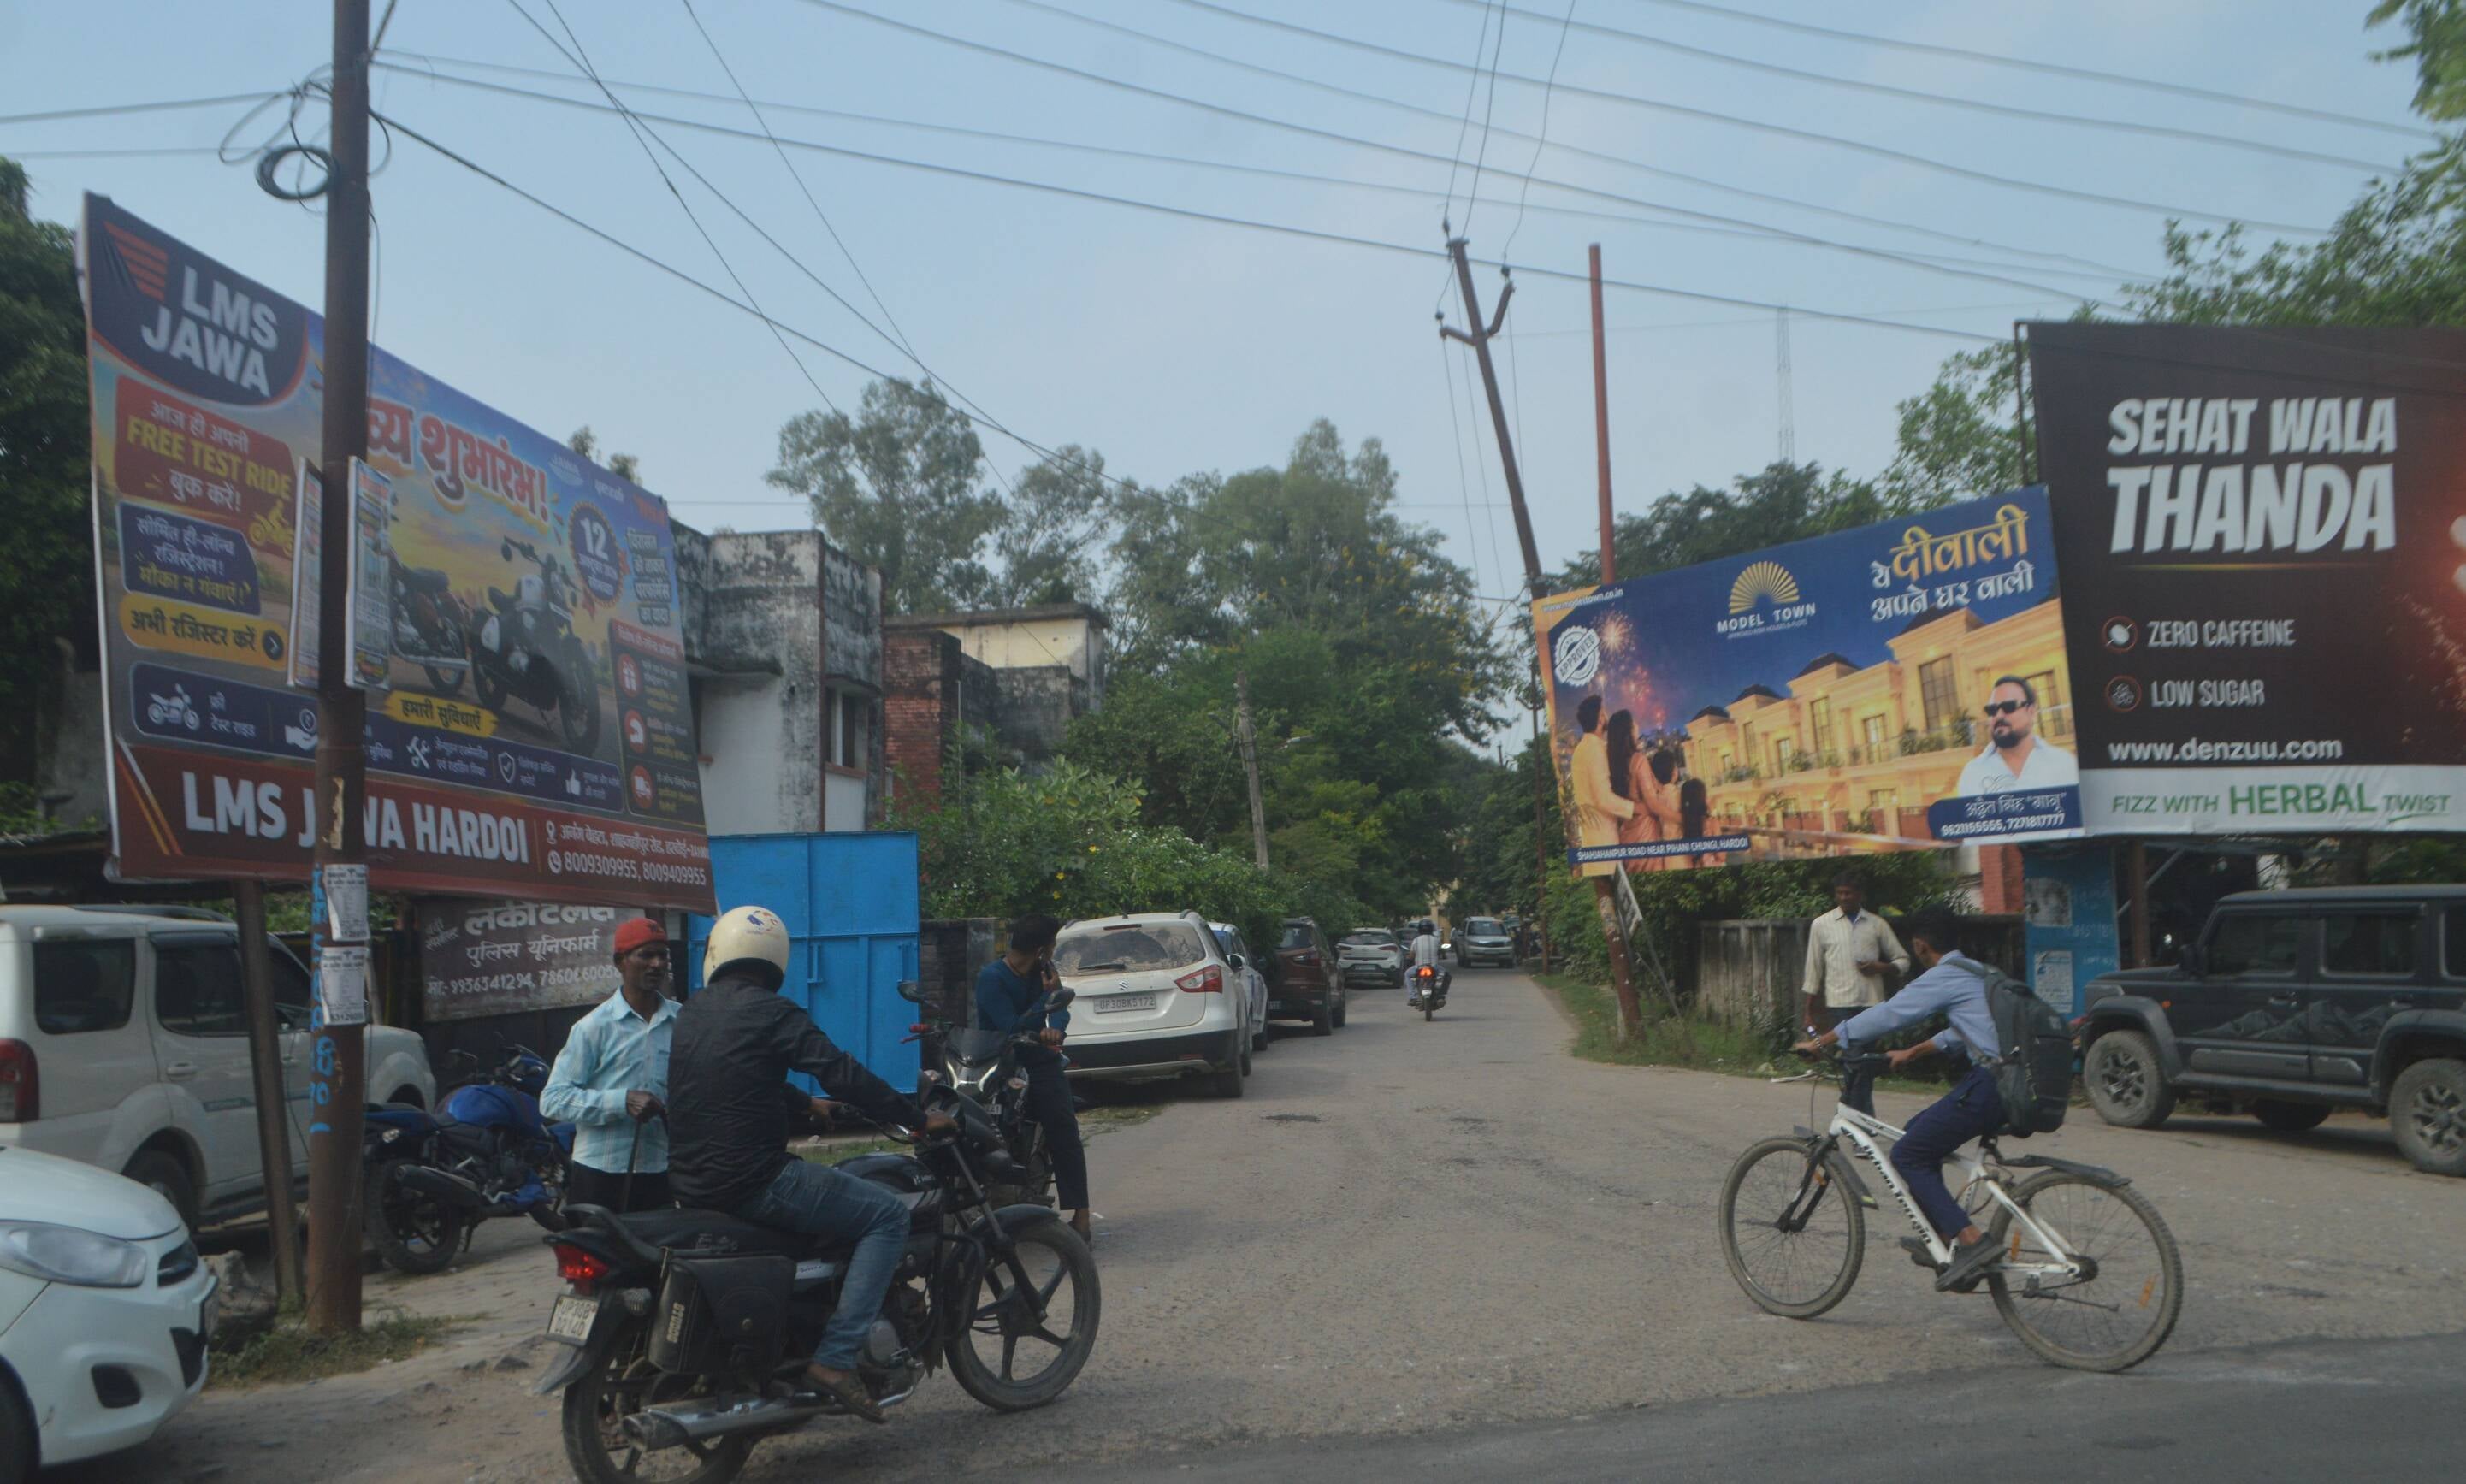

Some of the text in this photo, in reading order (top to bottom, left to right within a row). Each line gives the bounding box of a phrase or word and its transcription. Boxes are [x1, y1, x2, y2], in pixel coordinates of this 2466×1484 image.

[182, 264, 278, 352] LMS
[140, 305, 270, 398] JAWA
[151, 401, 250, 454] आज ही अपनी
[2107, 396, 2398, 457] SEHAT WALA
[127, 415, 292, 502] FREE TEST RIDE
[420, 414, 549, 523] शुभारंभ!
[2107, 462, 2397, 554] THANDA
[581, 517, 610, 561] 12
[1870, 504, 2030, 589] ये दीवाली
[1871, 559, 2035, 622] अपने घर वाली
[130, 606, 167, 636] अभी
[1717, 602, 1816, 633] MODEL TOWN
[2146, 618, 2297, 648] ZERO CAFFEINE
[1559, 634, 1596, 679] APPROVED
[2150, 678, 2266, 707] LOW SUGAR
[2107, 736, 2344, 762] www.denzuu.com
[182, 772, 287, 839] LMS
[412, 802, 529, 864] HARDOI
[2111, 782, 2451, 816] FIZZ WITH HERBAL TWIST
[1628, 846, 1647, 857] ROAD
[1647, 844, 1666, 855] NEAR
[642, 861, 707, 887] 8009409955
[465, 940, 521, 968] पुलिस
[1862, 1144, 1895, 1190] Urban
